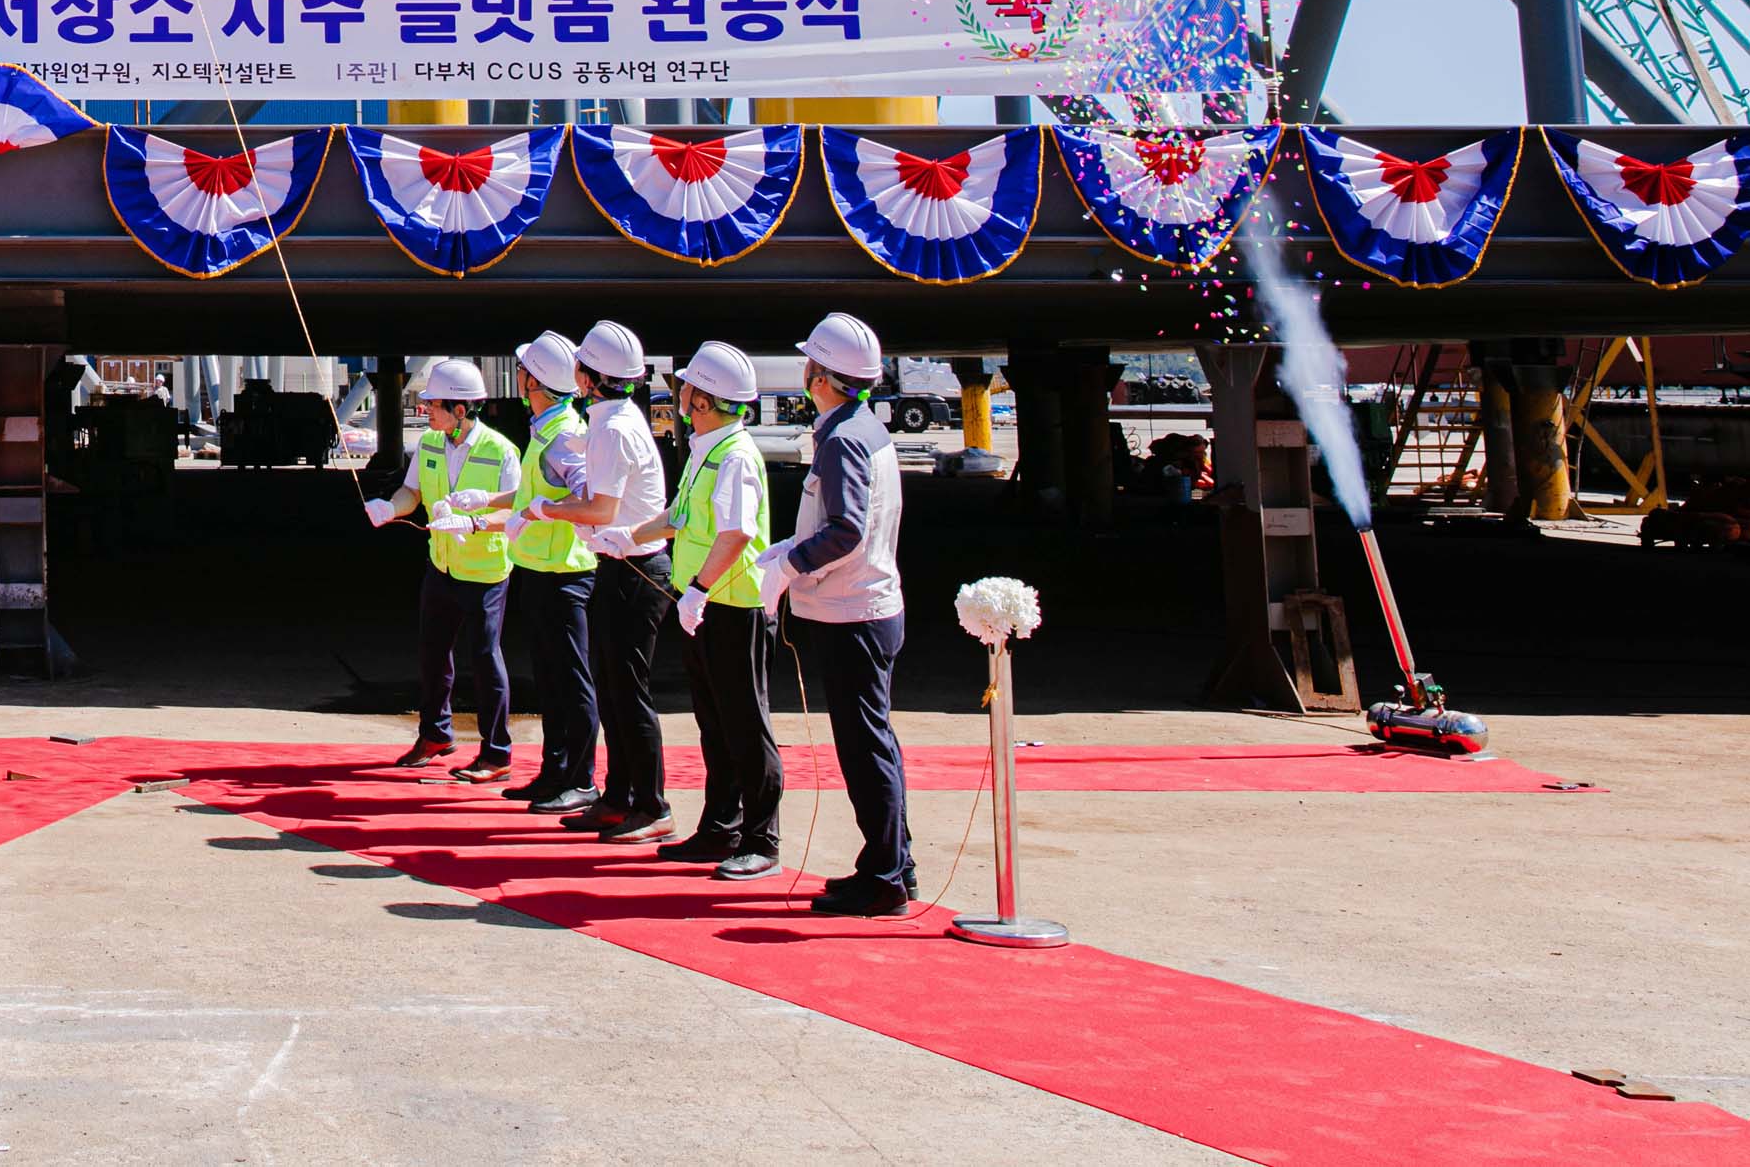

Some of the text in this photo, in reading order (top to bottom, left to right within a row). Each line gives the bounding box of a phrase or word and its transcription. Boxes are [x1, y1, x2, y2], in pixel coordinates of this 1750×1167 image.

[414, 61, 475, 82] 다부처
[487, 61, 563, 81] CCUS
[572, 61, 656, 85] 공동사업
[666, 60, 731, 83] 연구단
